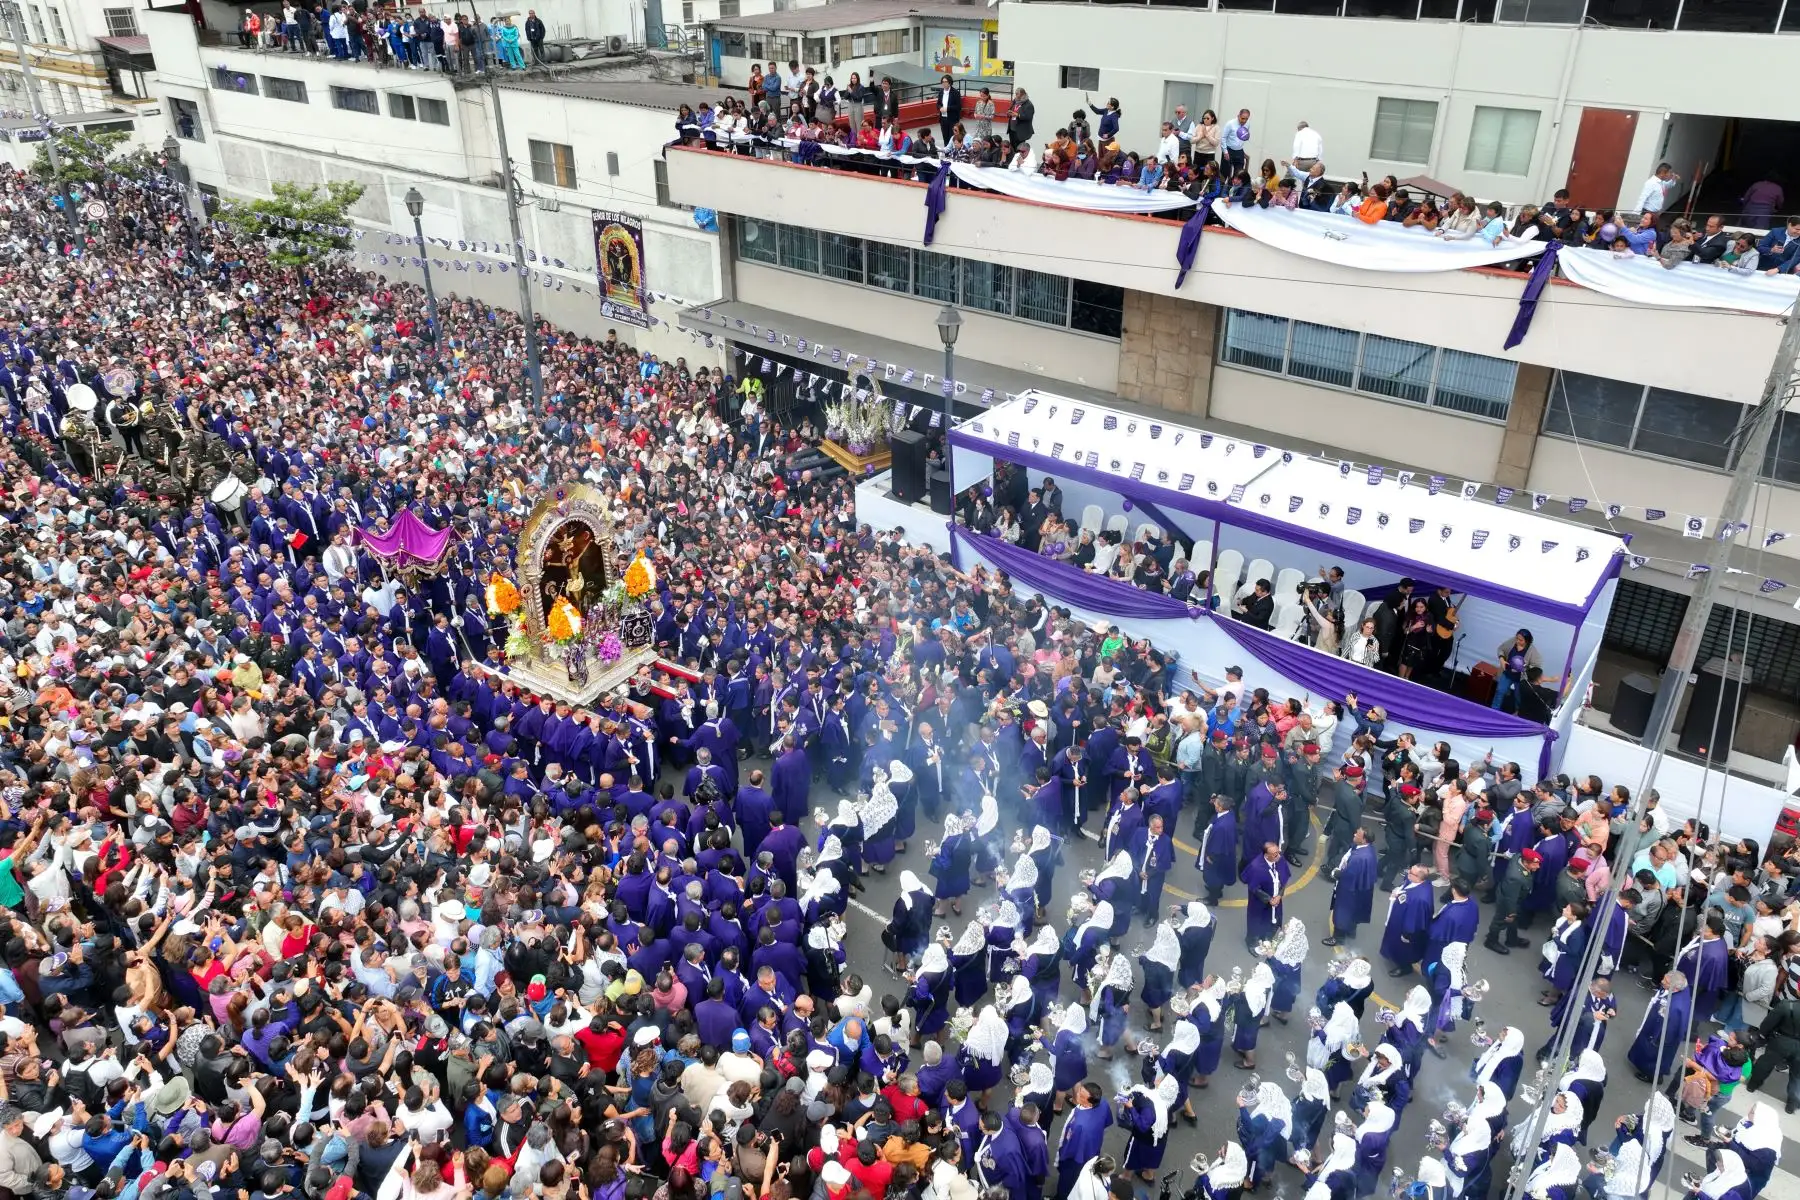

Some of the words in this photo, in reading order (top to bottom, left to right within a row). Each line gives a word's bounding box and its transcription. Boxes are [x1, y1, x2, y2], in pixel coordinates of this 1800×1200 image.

[592, 211, 605, 221] SEÑOR
[606, 212, 611, 220] DE
[620, 214, 640, 230] MILAGROS
[445, 989, 454, 1000] 21
